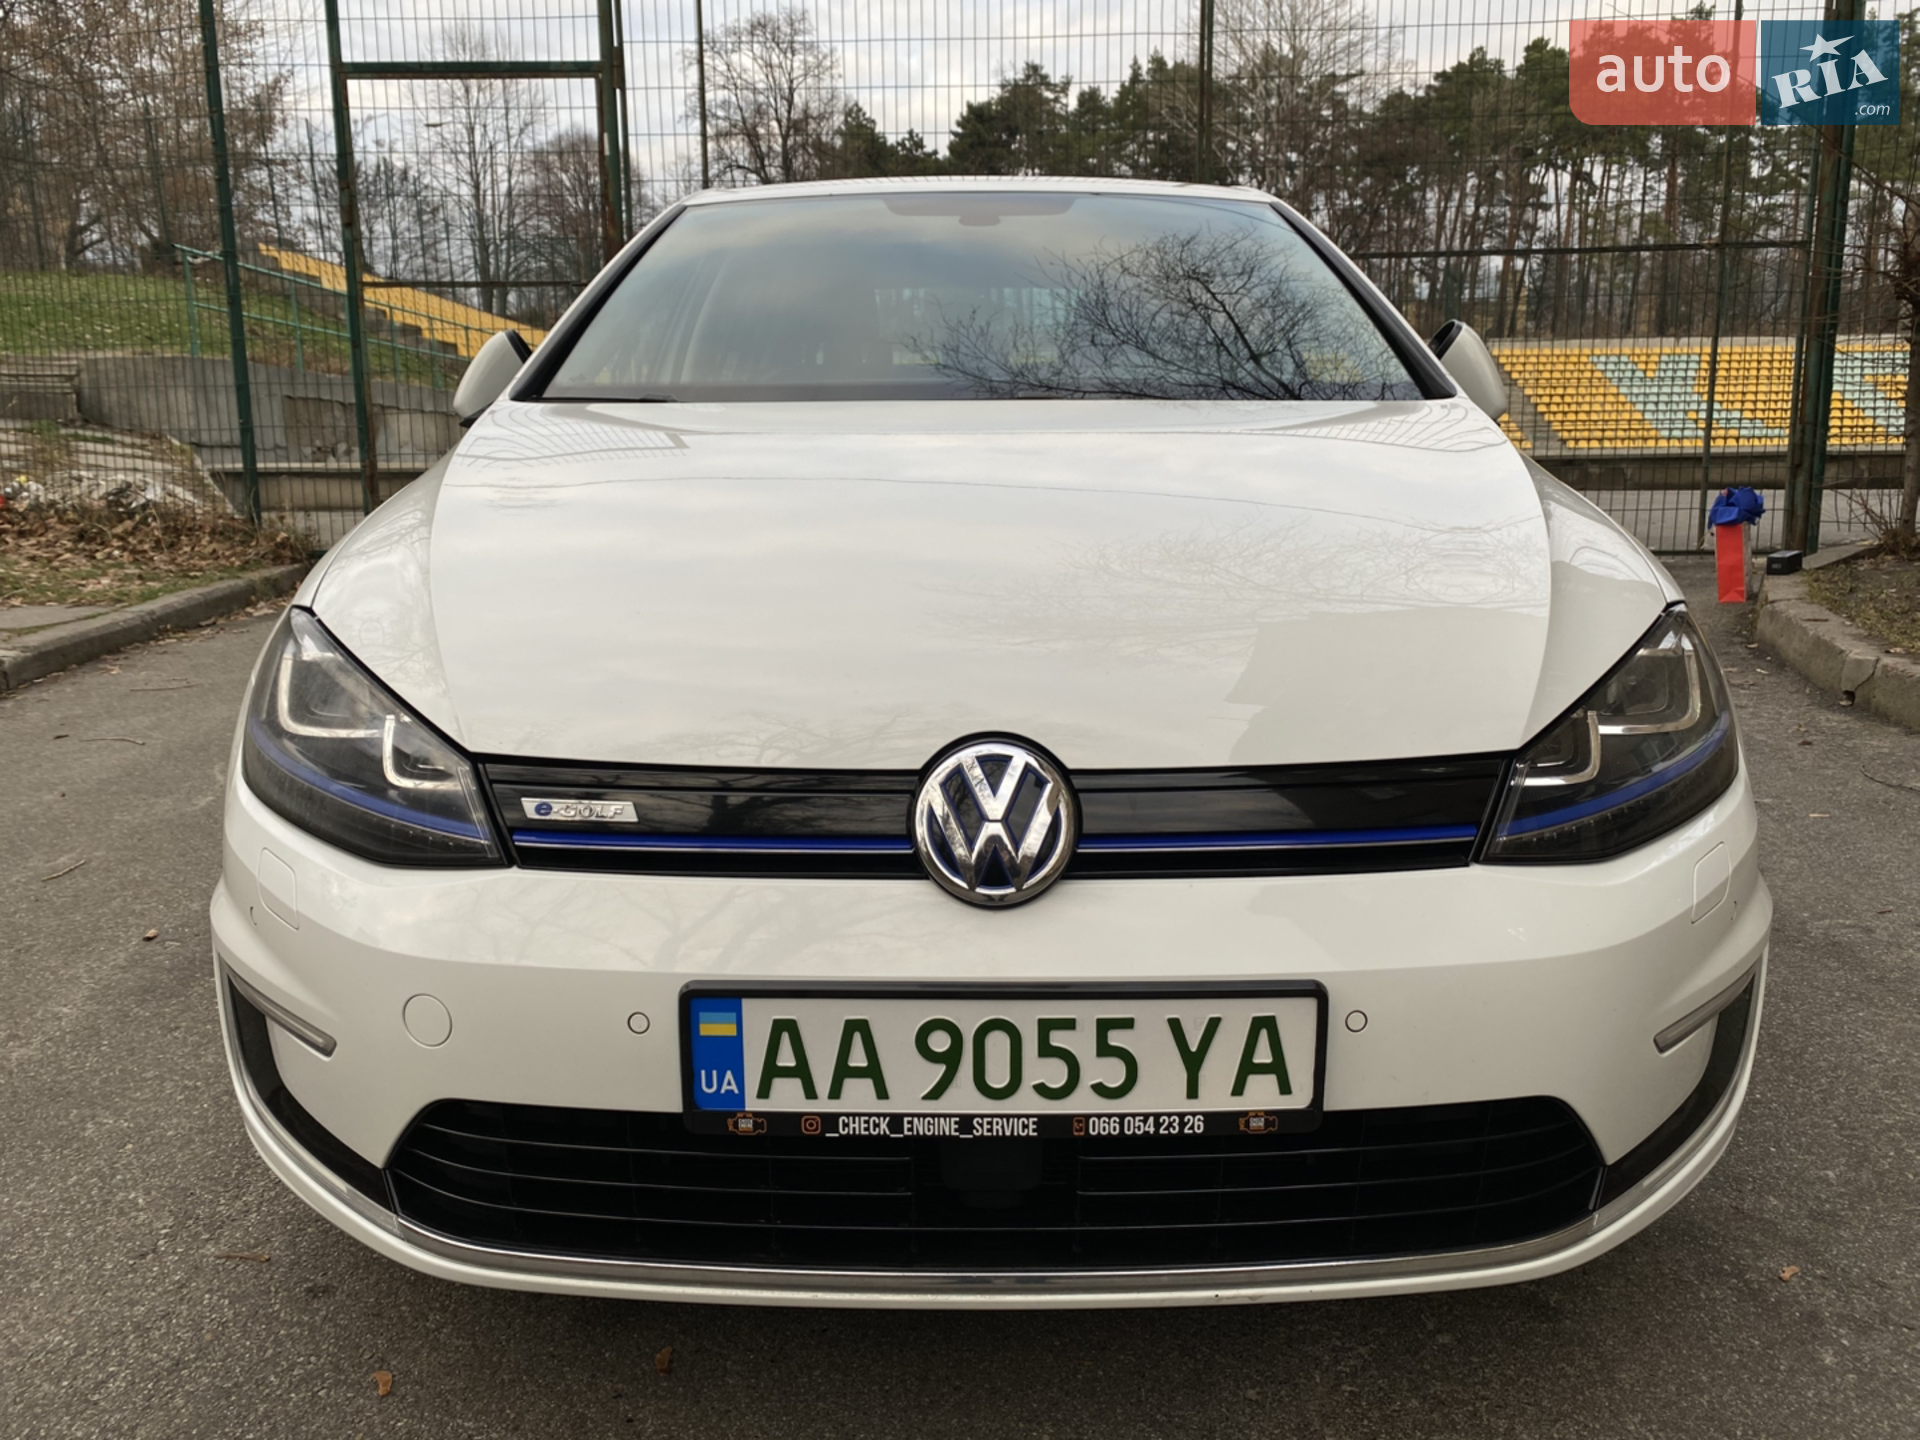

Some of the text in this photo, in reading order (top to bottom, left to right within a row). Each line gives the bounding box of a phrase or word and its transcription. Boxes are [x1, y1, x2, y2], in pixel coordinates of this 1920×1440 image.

[756, 1015, 1293, 1100] AA 9055 YA
[700, 1069, 739, 1094] UA
[1088, 1114, 1205, 1136] 066 054 23 26
